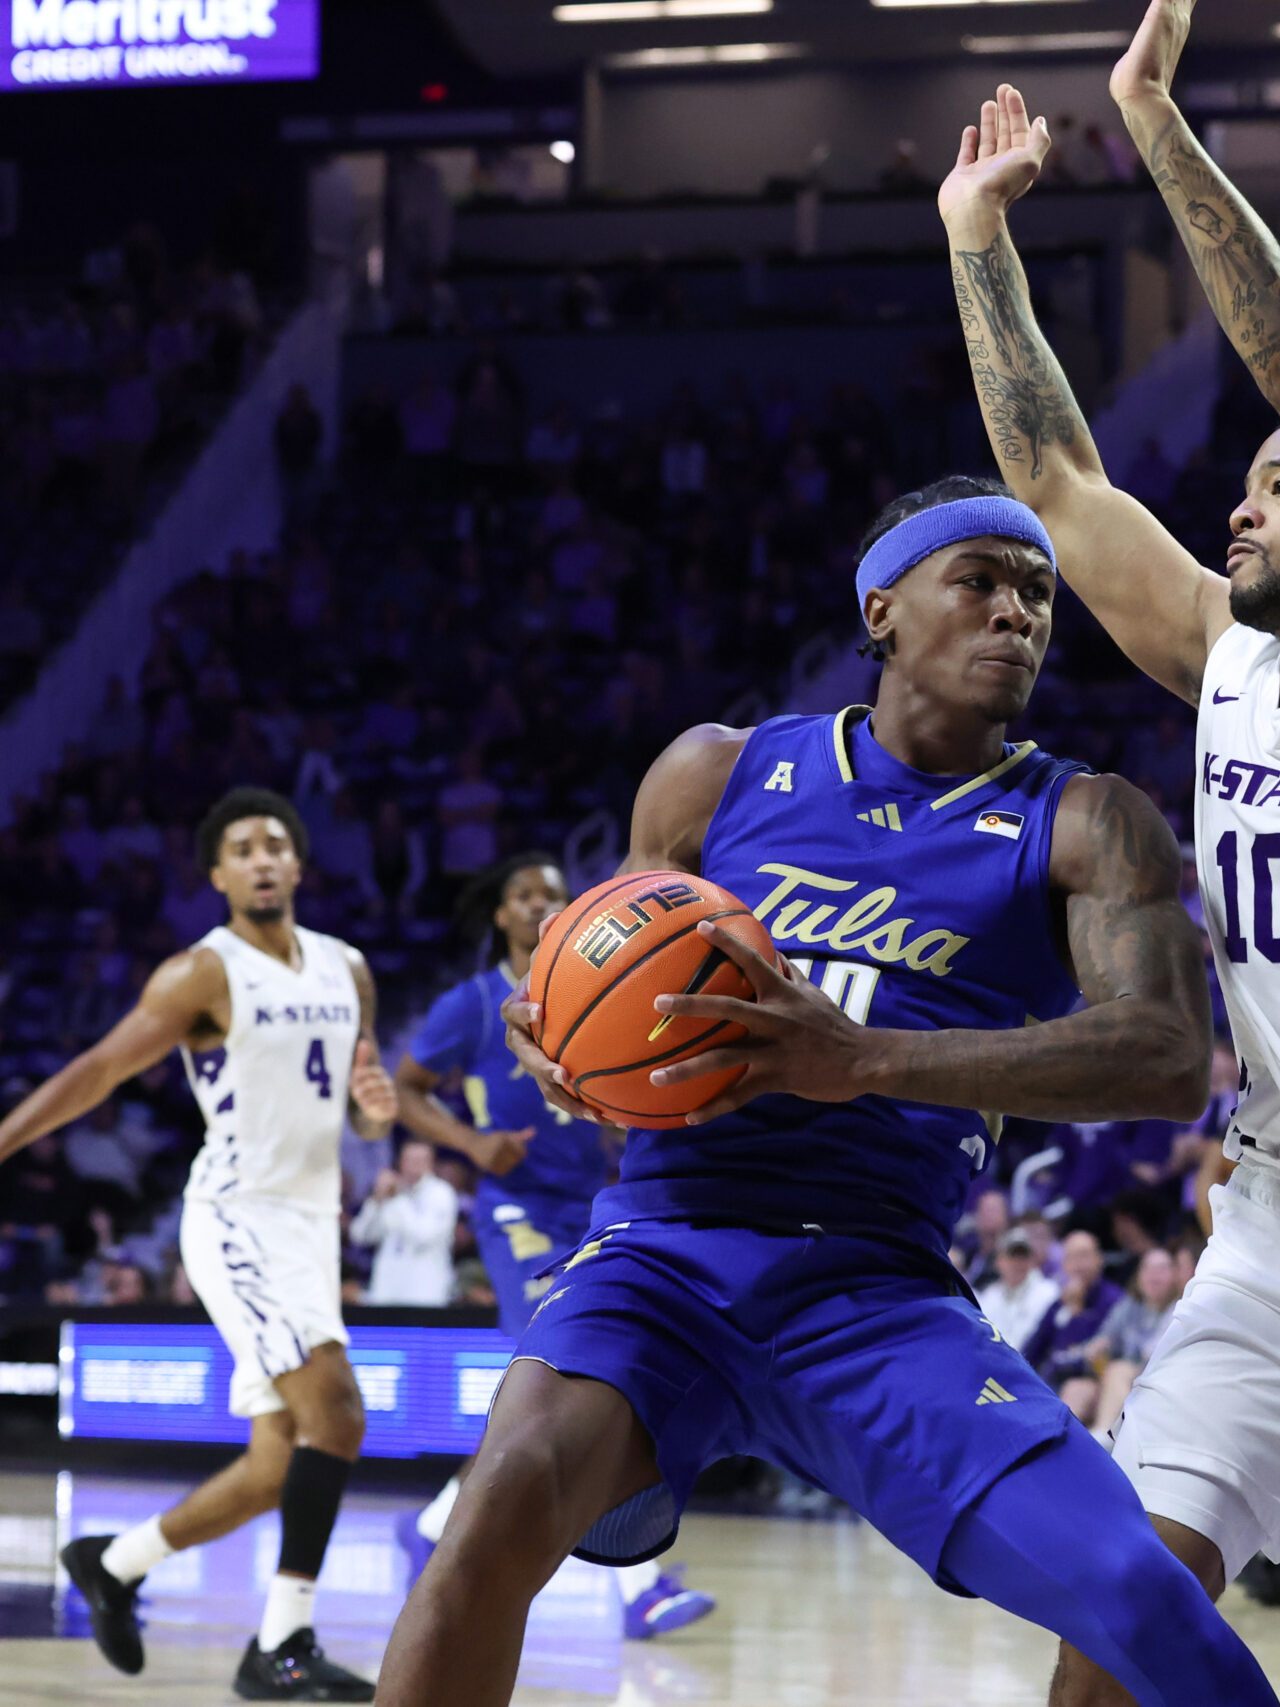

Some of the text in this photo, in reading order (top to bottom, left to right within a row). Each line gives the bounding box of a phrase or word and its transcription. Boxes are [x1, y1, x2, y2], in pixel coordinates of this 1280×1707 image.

[11, 47, 122, 84] CREDIT
[577, 882, 705, 970] ELITE
[756, 863, 970, 977] Tulsa
[255, 1004, 351, 1026] K-STATE
[305, 1038, 331, 1099] 4
